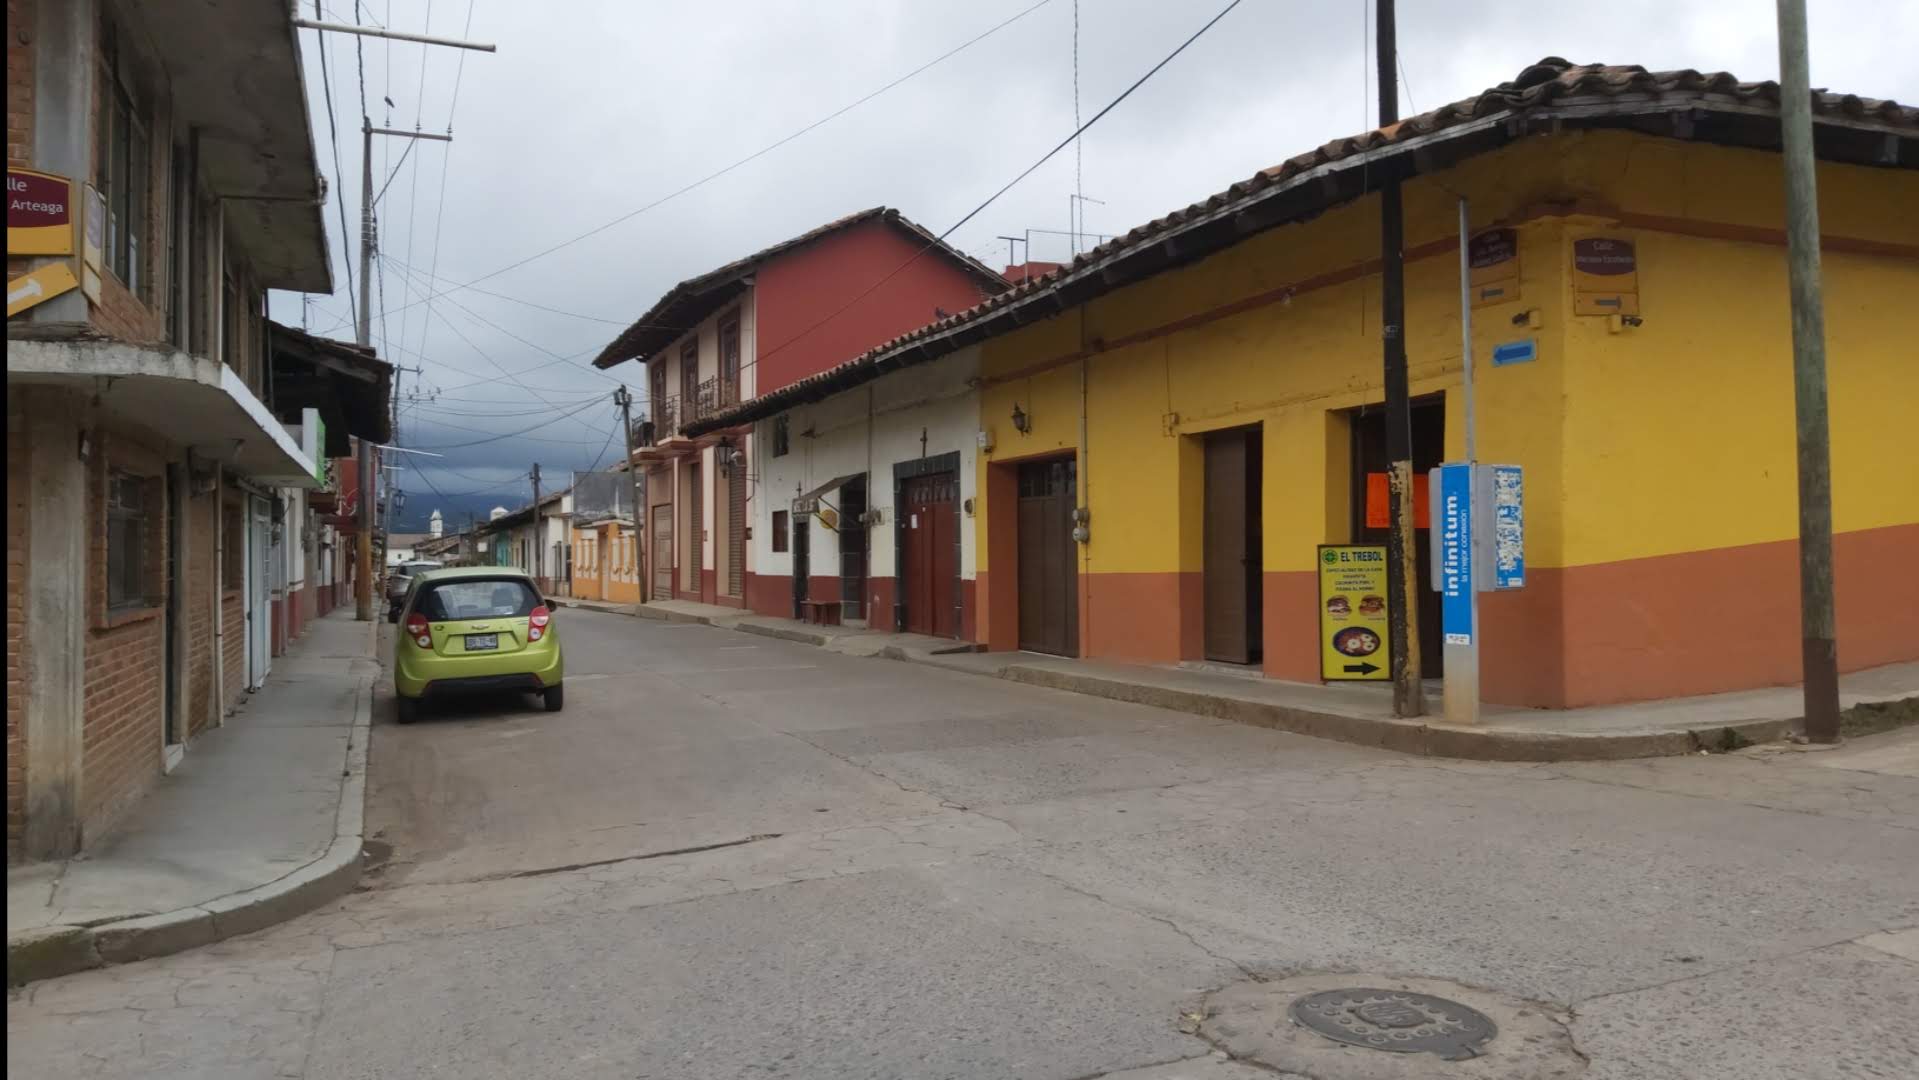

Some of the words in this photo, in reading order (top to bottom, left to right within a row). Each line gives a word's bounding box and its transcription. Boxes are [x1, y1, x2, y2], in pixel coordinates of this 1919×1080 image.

[11, 200, 64, 215] Arteaga
[1444, 495, 1459, 597] infinitum
[1341, 551, 1350, 561] EL
[1352, 551, 1383, 561] TREBOL
